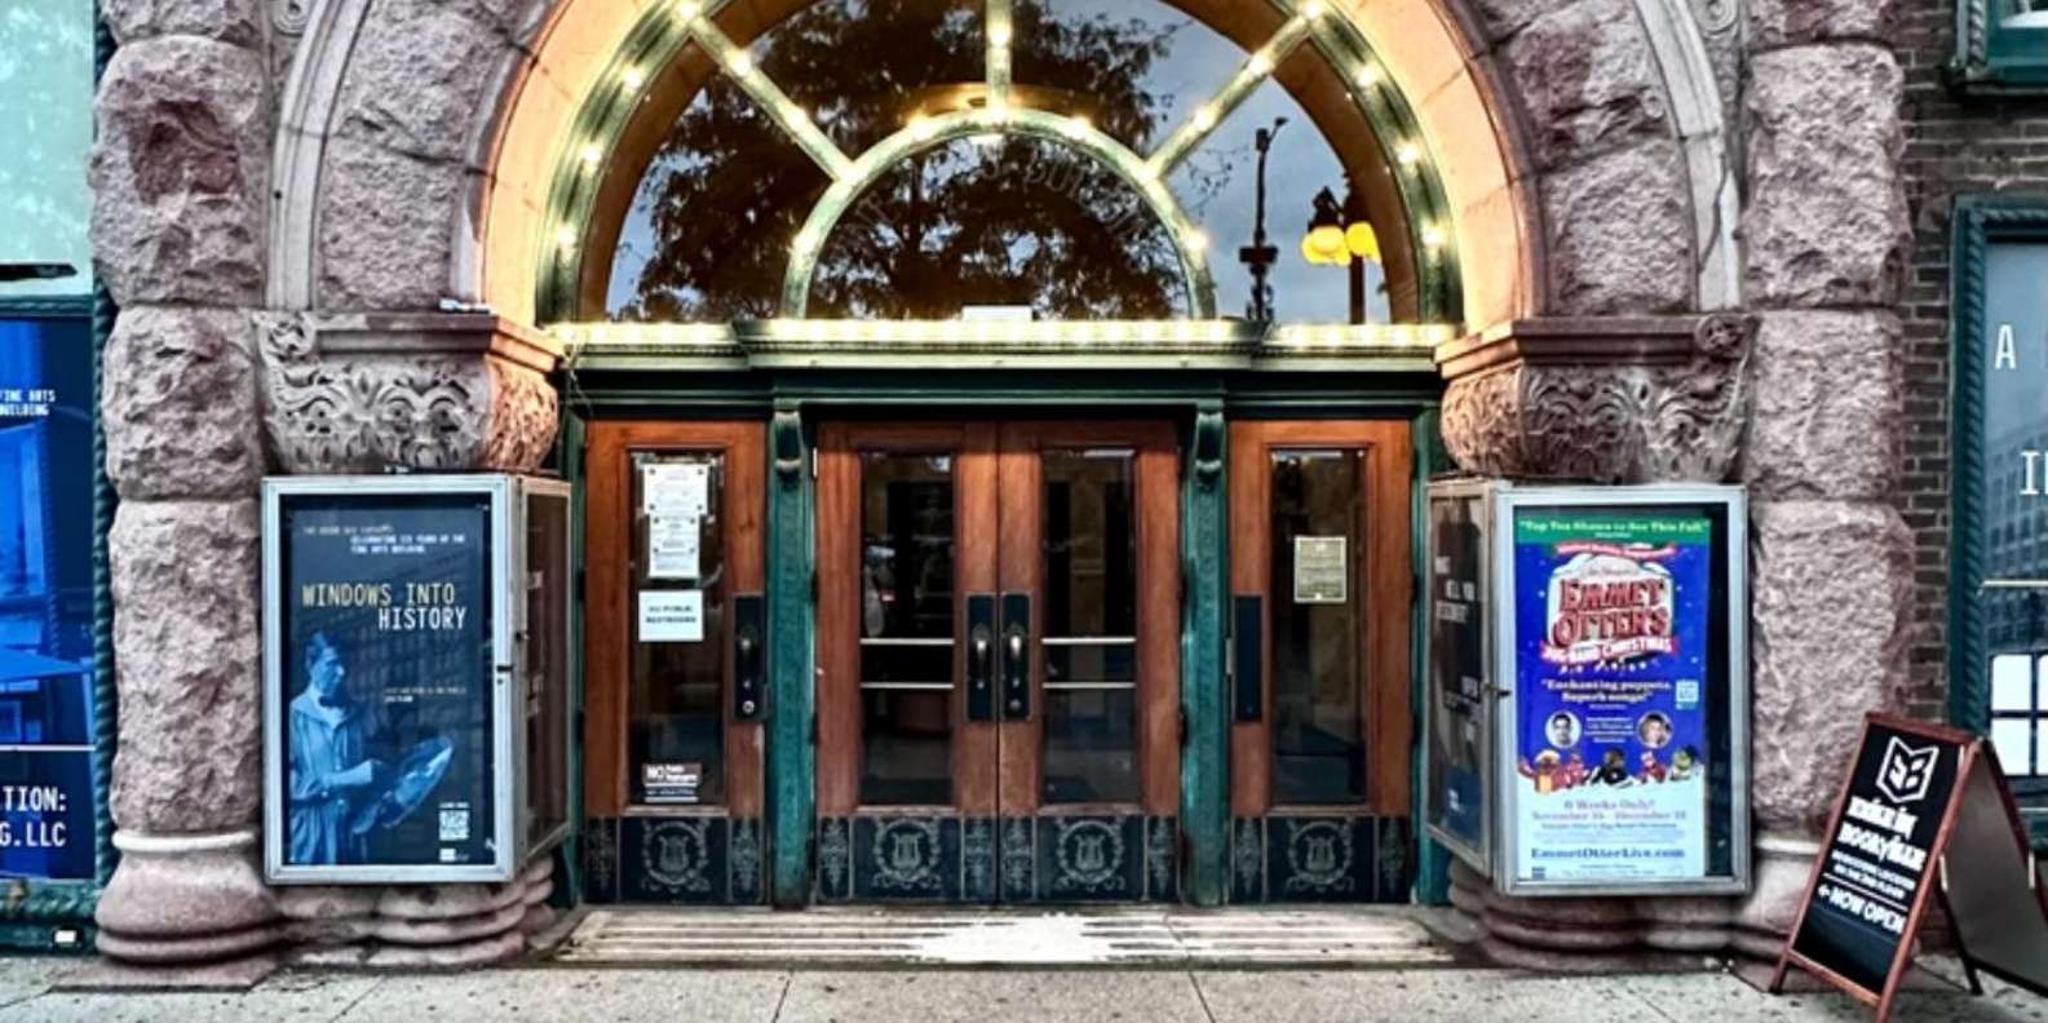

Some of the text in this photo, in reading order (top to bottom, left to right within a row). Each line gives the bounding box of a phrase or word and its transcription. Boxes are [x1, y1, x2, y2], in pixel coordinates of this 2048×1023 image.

[1995, 324, 2017, 369] A
[2019, 450, 2048, 496] I
[302, 583, 456, 606] WINDOWS INTO
[1560, 578, 1665, 612] EMMET
[379, 607, 467, 630] HISTORY
[1829, 886, 1907, 934] NOW OPEN
